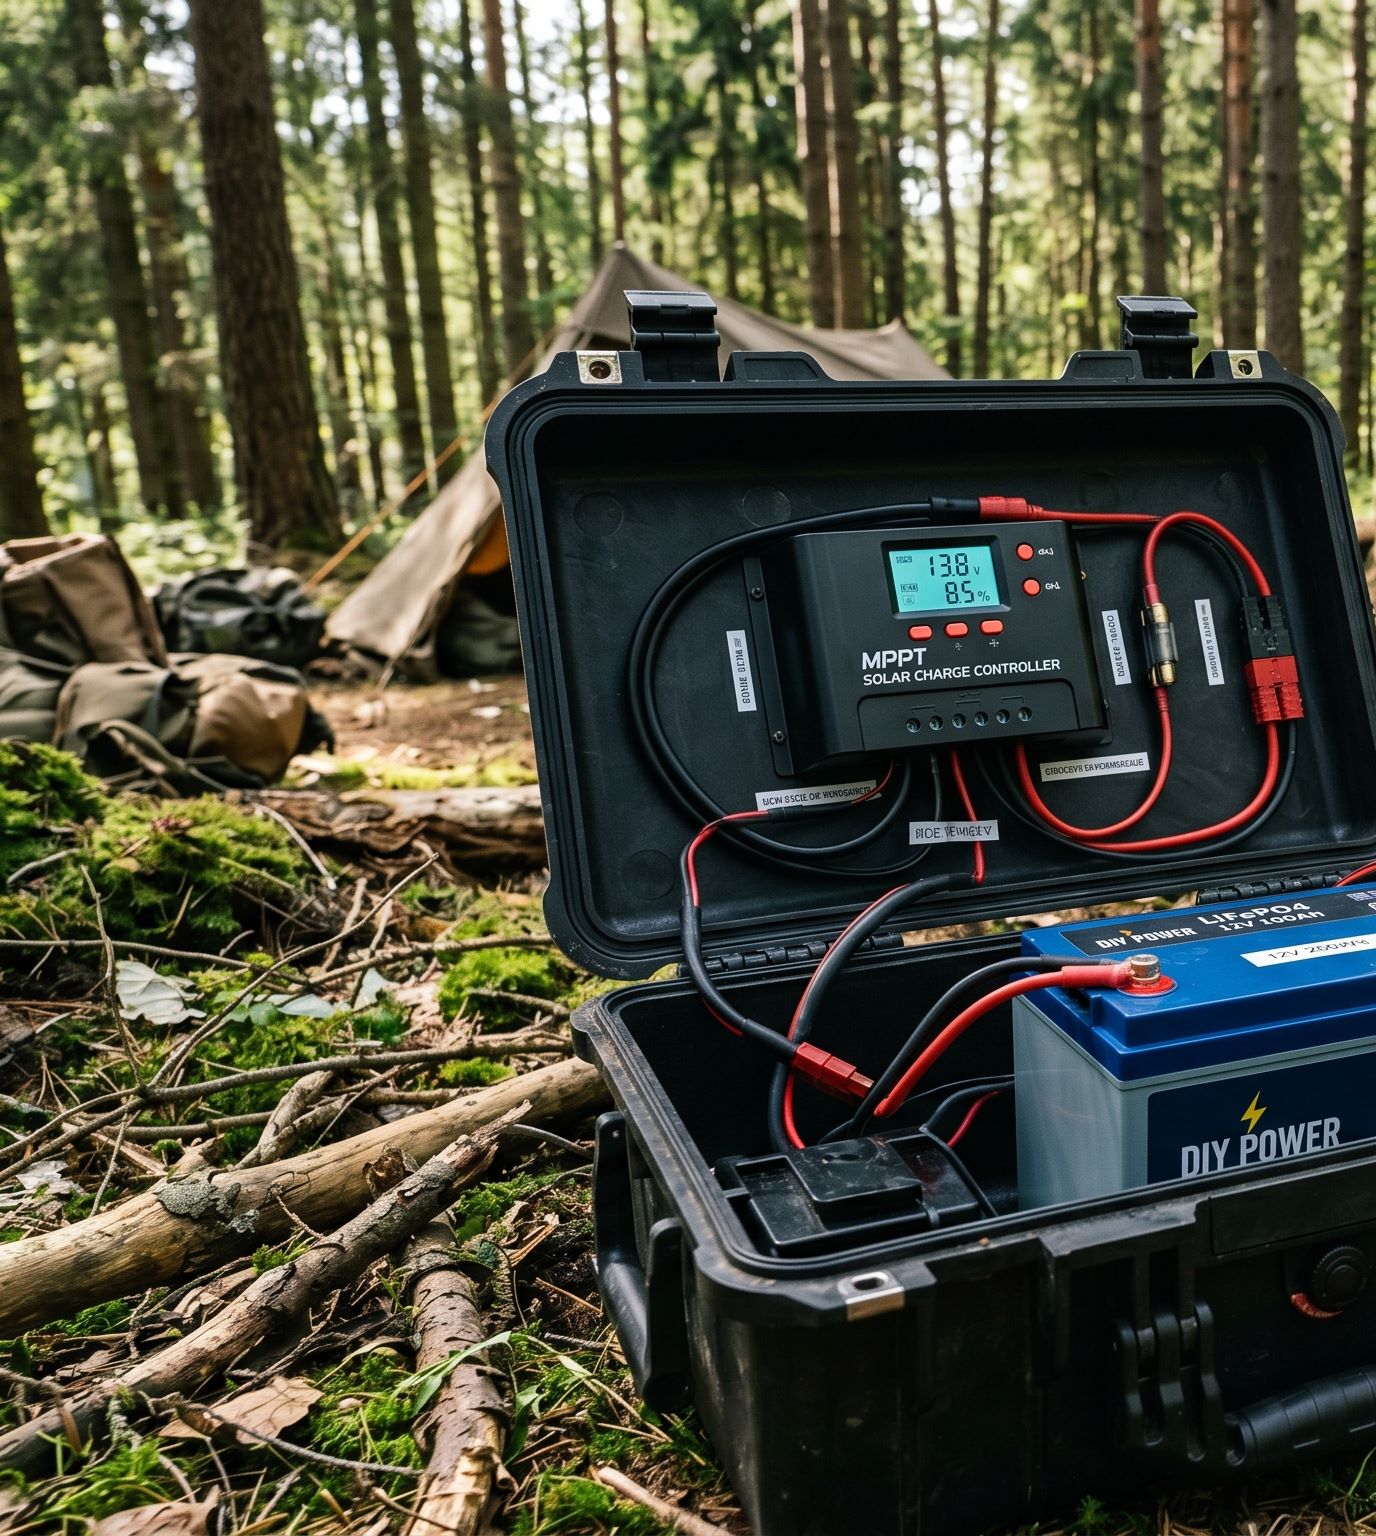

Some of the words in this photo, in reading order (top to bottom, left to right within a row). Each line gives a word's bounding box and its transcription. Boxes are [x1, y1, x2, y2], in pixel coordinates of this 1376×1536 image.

[929, 553, 969, 577] 13.8
[973, 566, 981, 576] V
[944, 580, 975, 605] 8.5
[978, 590, 990, 602] %
[862, 647, 927, 670] MPPT
[863, 671, 911, 686] SOLAR
[914, 666, 970, 681] CHARGE
[974, 658, 1061, 677] CONTROLLER
[1218, 920, 1254, 932] 12V
[1263, 911, 1325, 925] 100Ah
[1096, 937, 1127, 949] DIY
[1131, 927, 1198, 943] POWER
[1268, 949, 1298, 959] 12V
[1181, 1138, 1230, 1179] DIY
[1240, 1117, 1341, 1167] POWER
